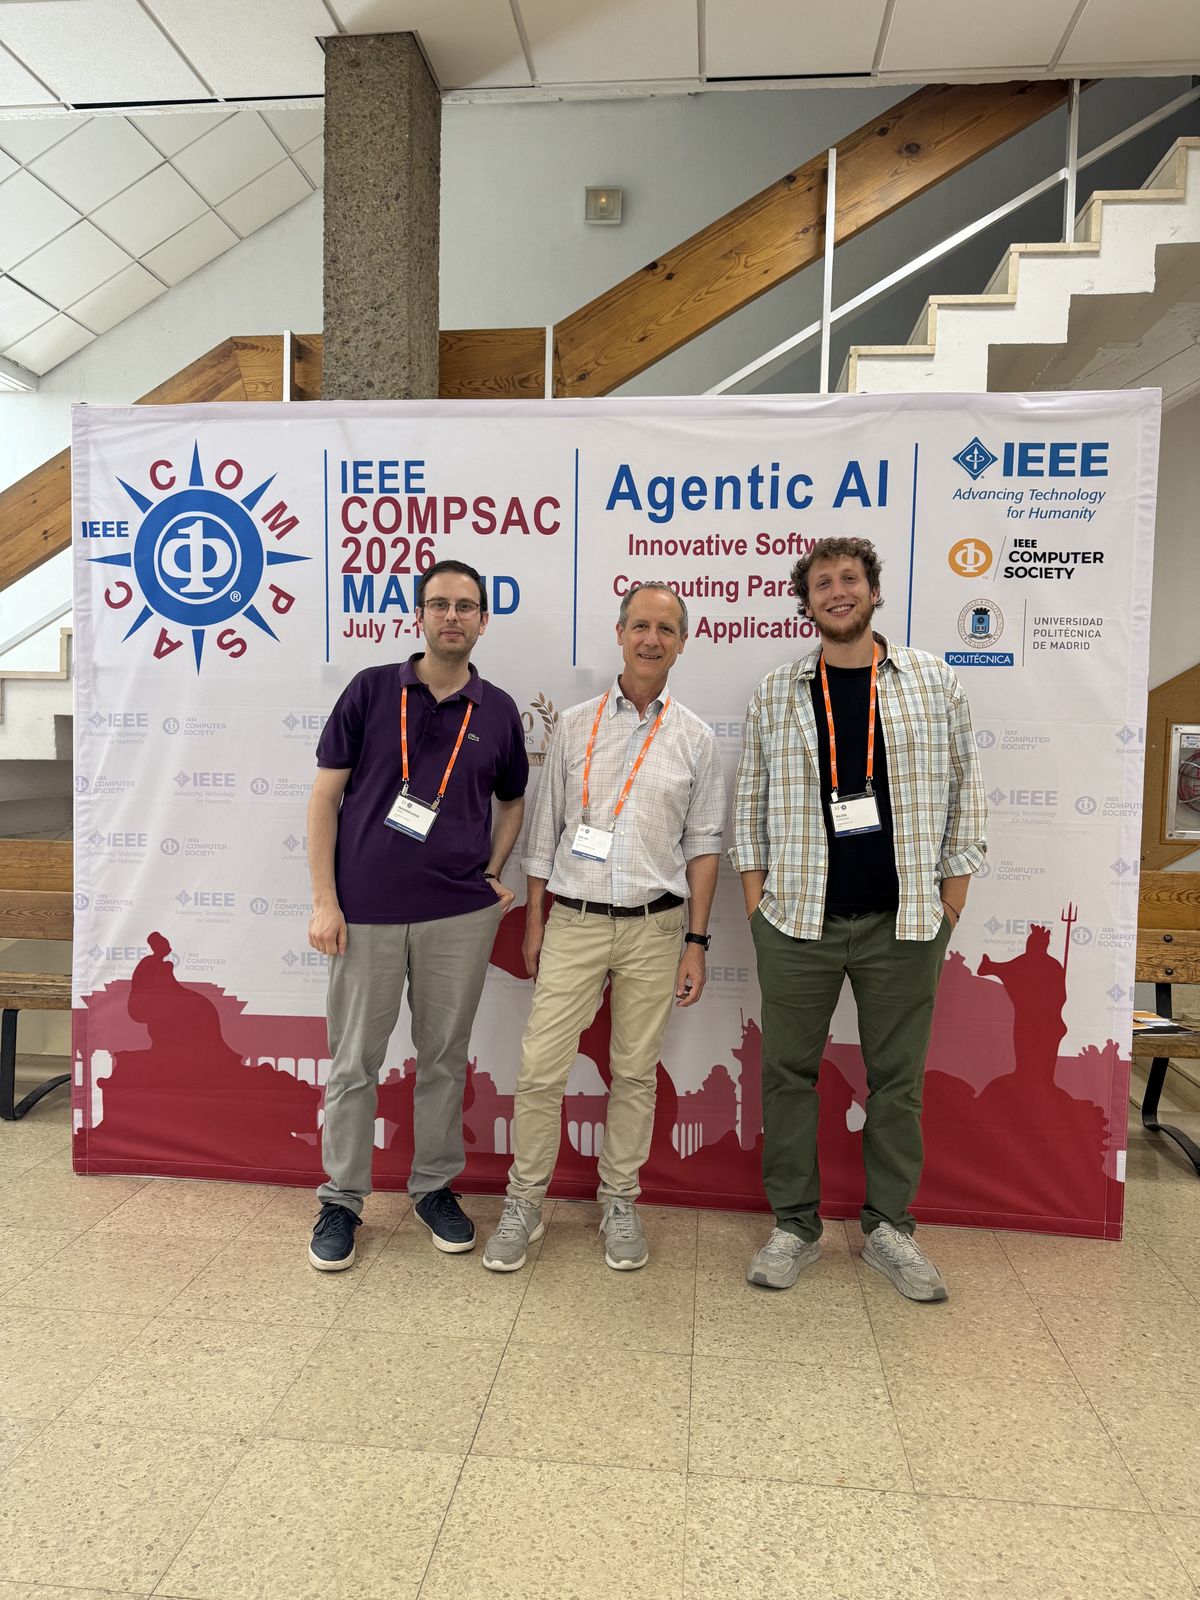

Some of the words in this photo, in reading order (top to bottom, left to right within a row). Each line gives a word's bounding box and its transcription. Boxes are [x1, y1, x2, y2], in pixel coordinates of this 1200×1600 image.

[1003, 442, 1109, 477] IEEE
[341, 460, 426, 494] IEEE
[605, 462, 814, 523] Agentic
[832, 459, 889, 508] AI
[952, 487, 1024, 504] Advancing
[1029, 488, 1106, 504] Technology
[341, 496, 561, 535] COMPSAC
[1006, 506, 1025, 520] for
[1028, 507, 1096, 522] Humanity
[81, 521, 129, 538] IEEE
[628, 533, 748, 556] Innovative
[1013, 538, 1038, 549] IEEE
[341, 536, 436, 574] 2026
[1008, 550, 1104, 564] COMPUTER
[1003, 566, 1075, 580] SOCIETY
[747, 575, 796, 597] Para
[695, 616, 820, 643] Applicatio
[1033, 617, 1104, 626] UNIVERSIDAD
[342, 618, 386, 644] July
[392, 619, 421, 639] 7-1
[1032, 627, 1102, 638] POLITÉCNICA
[1032, 641, 1047, 650] DE
[1050, 642, 1090, 651] MADRID
[948, 653, 1012, 665] POLITÉCNICA
[108, 713, 148, 728] IEEE
[193, 772, 236, 787] IEEE
[1009, 789, 1058, 806] IEEE
[107, 832, 148, 847] IEEE
[194, 891, 235, 907] IEEE
